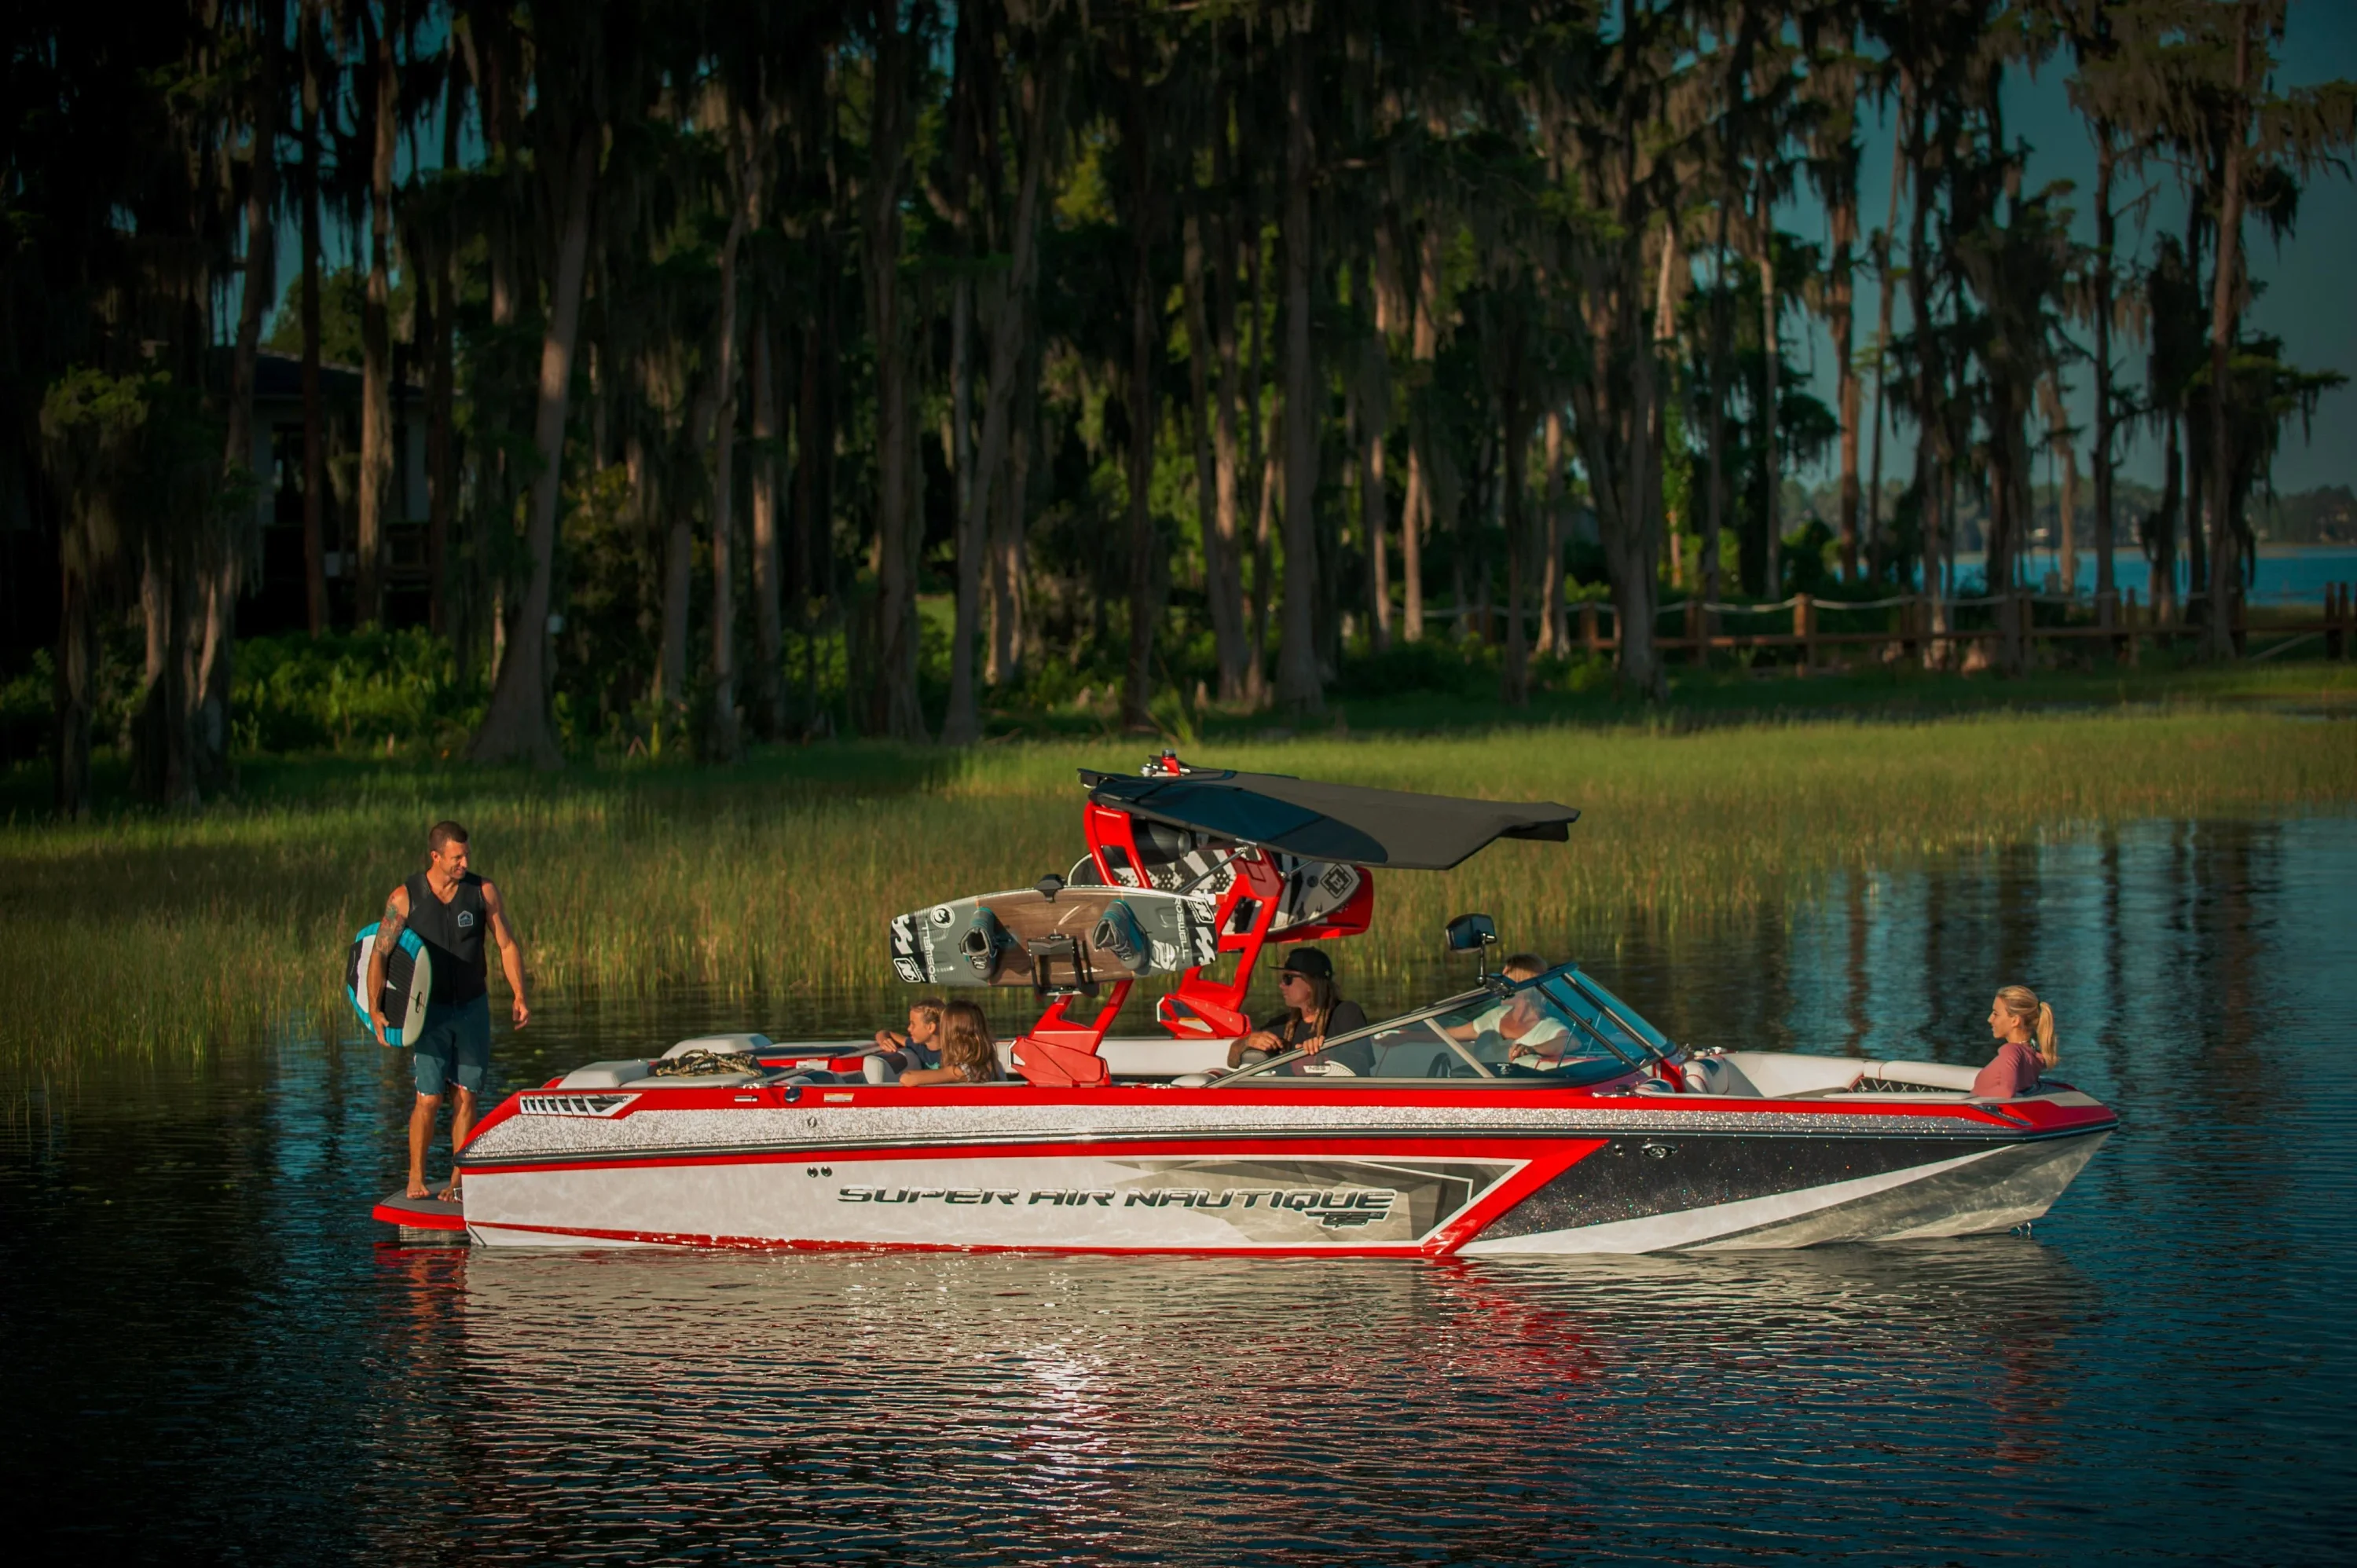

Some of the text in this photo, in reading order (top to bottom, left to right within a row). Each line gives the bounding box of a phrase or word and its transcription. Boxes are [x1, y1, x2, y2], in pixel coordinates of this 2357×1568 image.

[922, 919, 938, 984] ROSWELL
[1175, 898, 1189, 960] ROSWELL
[837, 1184, 1397, 1211] SUPER AIR NAUTIQUE
